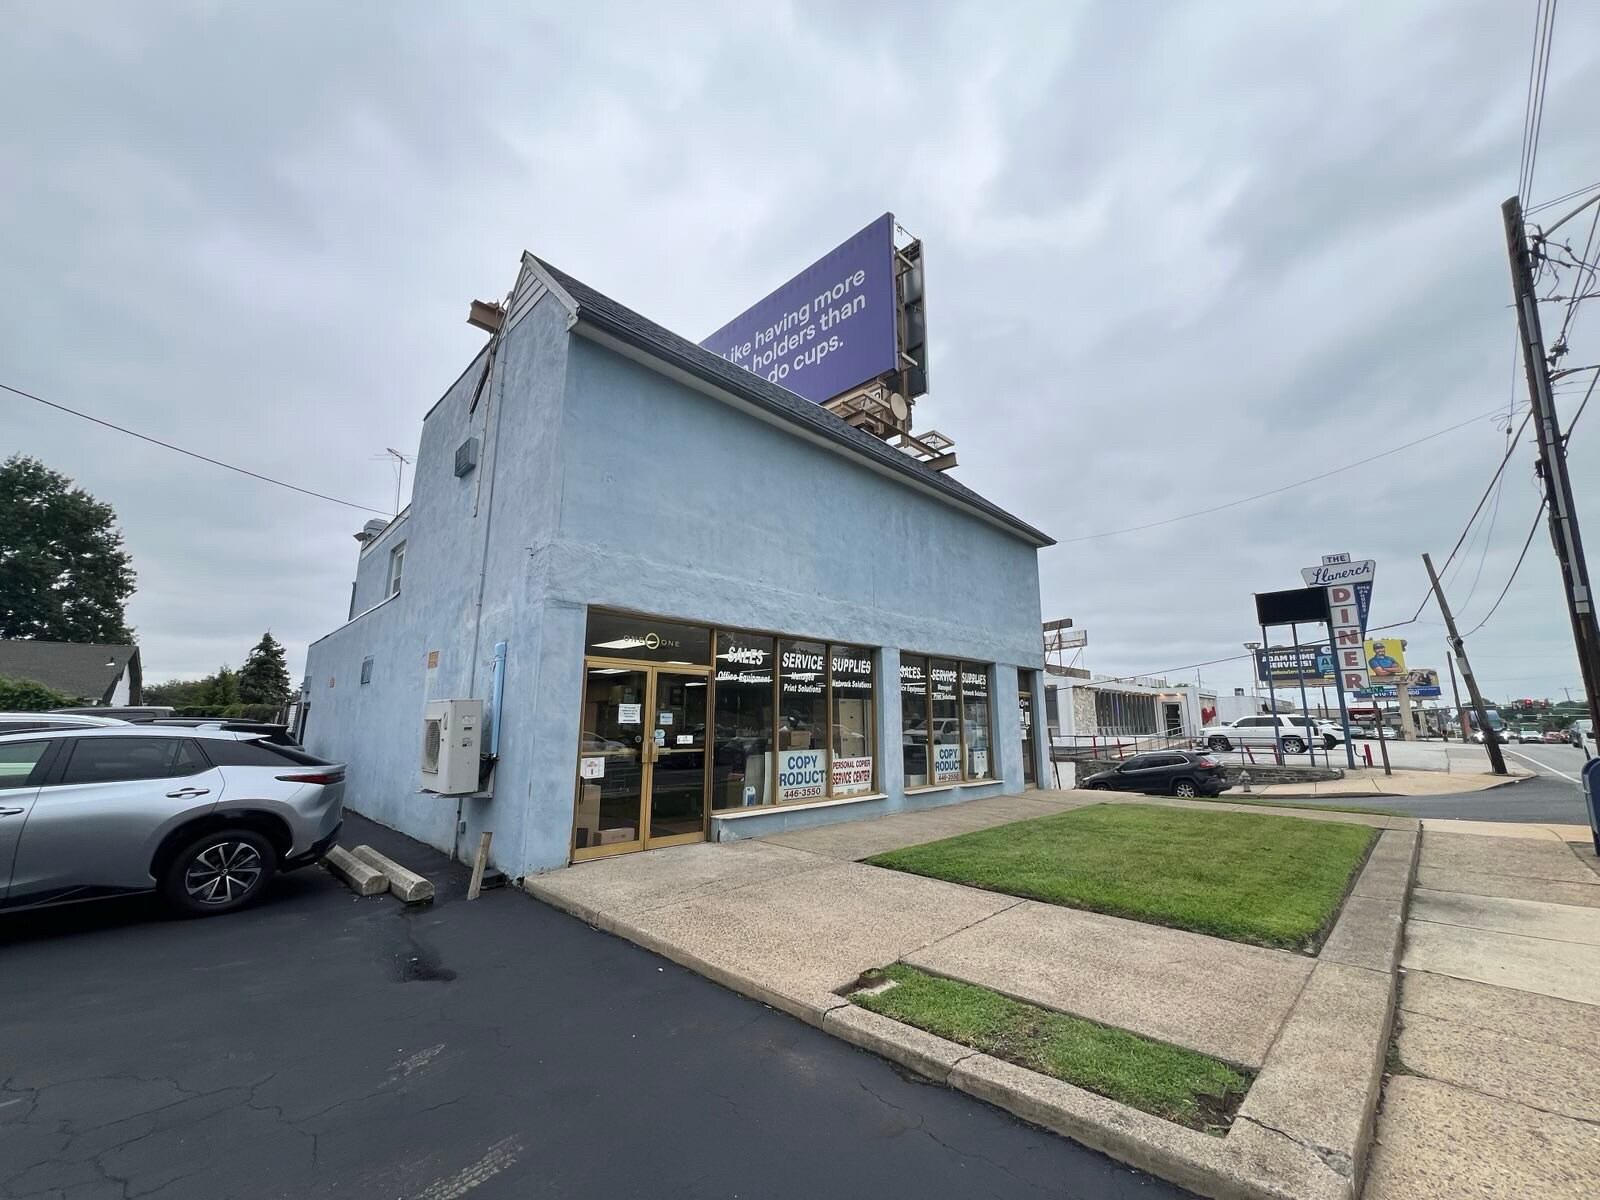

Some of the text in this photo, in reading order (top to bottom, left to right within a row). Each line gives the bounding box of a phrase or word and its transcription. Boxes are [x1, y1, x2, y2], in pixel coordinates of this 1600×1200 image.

[723, 269, 865, 364] ike having more
[753, 294, 866, 373] holders than
[768, 334, 843, 384] do cups.
[1326, 554, 1346, 563] THE
[1309, 561, 1370, 586] Llanerch
[660, 639, 680, 648] ONE
[1331, 587, 1363, 690] DINER
[727, 646, 764, 666] SALES
[782, 652, 824, 671] SERVICE
[831, 657, 871, 674] SUPPLIES
[899, 665, 921, 679] SALES
[738, 671, 771, 683] Equipment
[931, 668, 957, 682] SERVICE
[961, 672, 987, 685] SUPPLIES
[783, 683, 822, 693] Print Solutions
[831, 679, 872, 689] Network Solutions
[939, 748, 958, 760] COPY
[787, 755, 818, 770] COPY
[832, 759, 871, 770] PERSONAL COPIER
[935, 760, 961, 772] RODUCT
[779, 769, 826, 787] RODUCT
[832, 769, 871, 785] SERVICE CENTER
[783, 787, 821, 799] 446-3550
